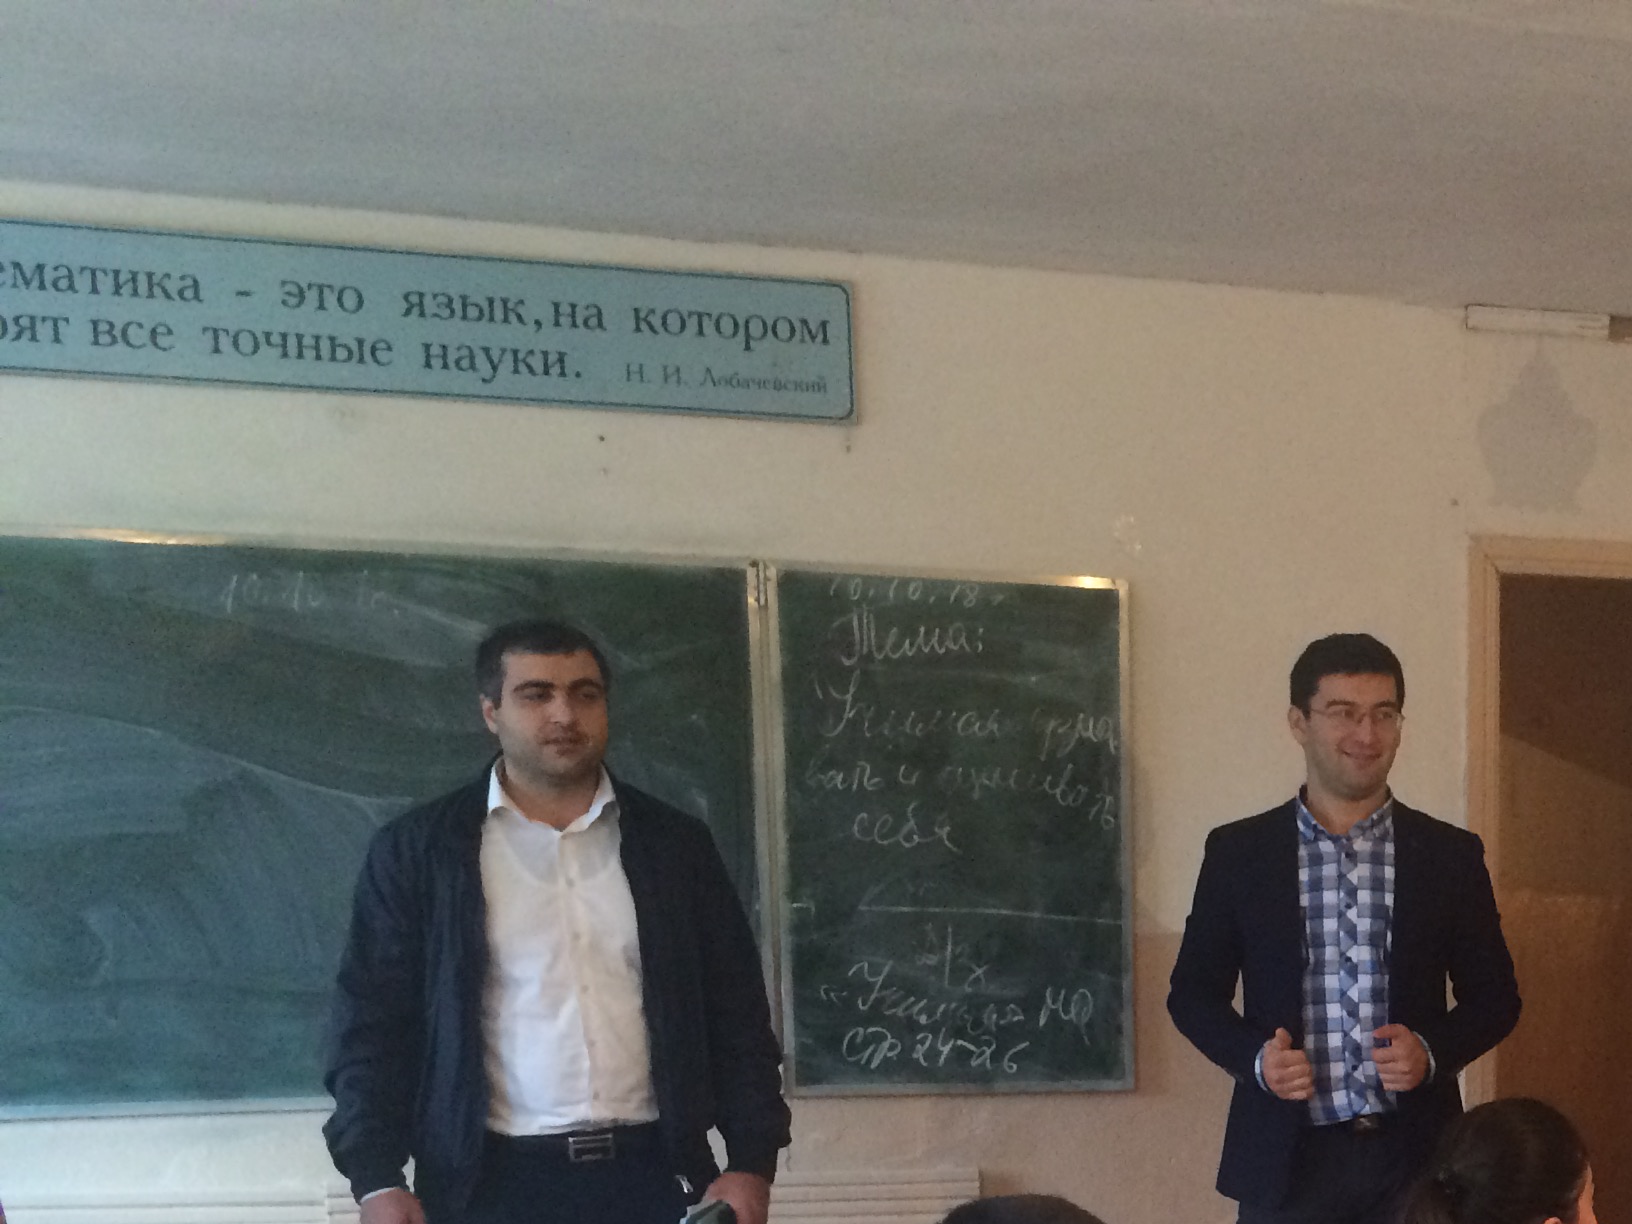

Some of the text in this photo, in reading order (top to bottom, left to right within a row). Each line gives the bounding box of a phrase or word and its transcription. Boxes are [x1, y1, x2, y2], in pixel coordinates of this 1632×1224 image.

[280, 278, 366, 315] это
[631, 306, 831, 352] котором
[90, 318, 175, 352] все
[201, 323, 394, 367] точные
[422, 337, 584, 380] науки.
[624, 362, 828, 394] Н. И. Лобачевский
